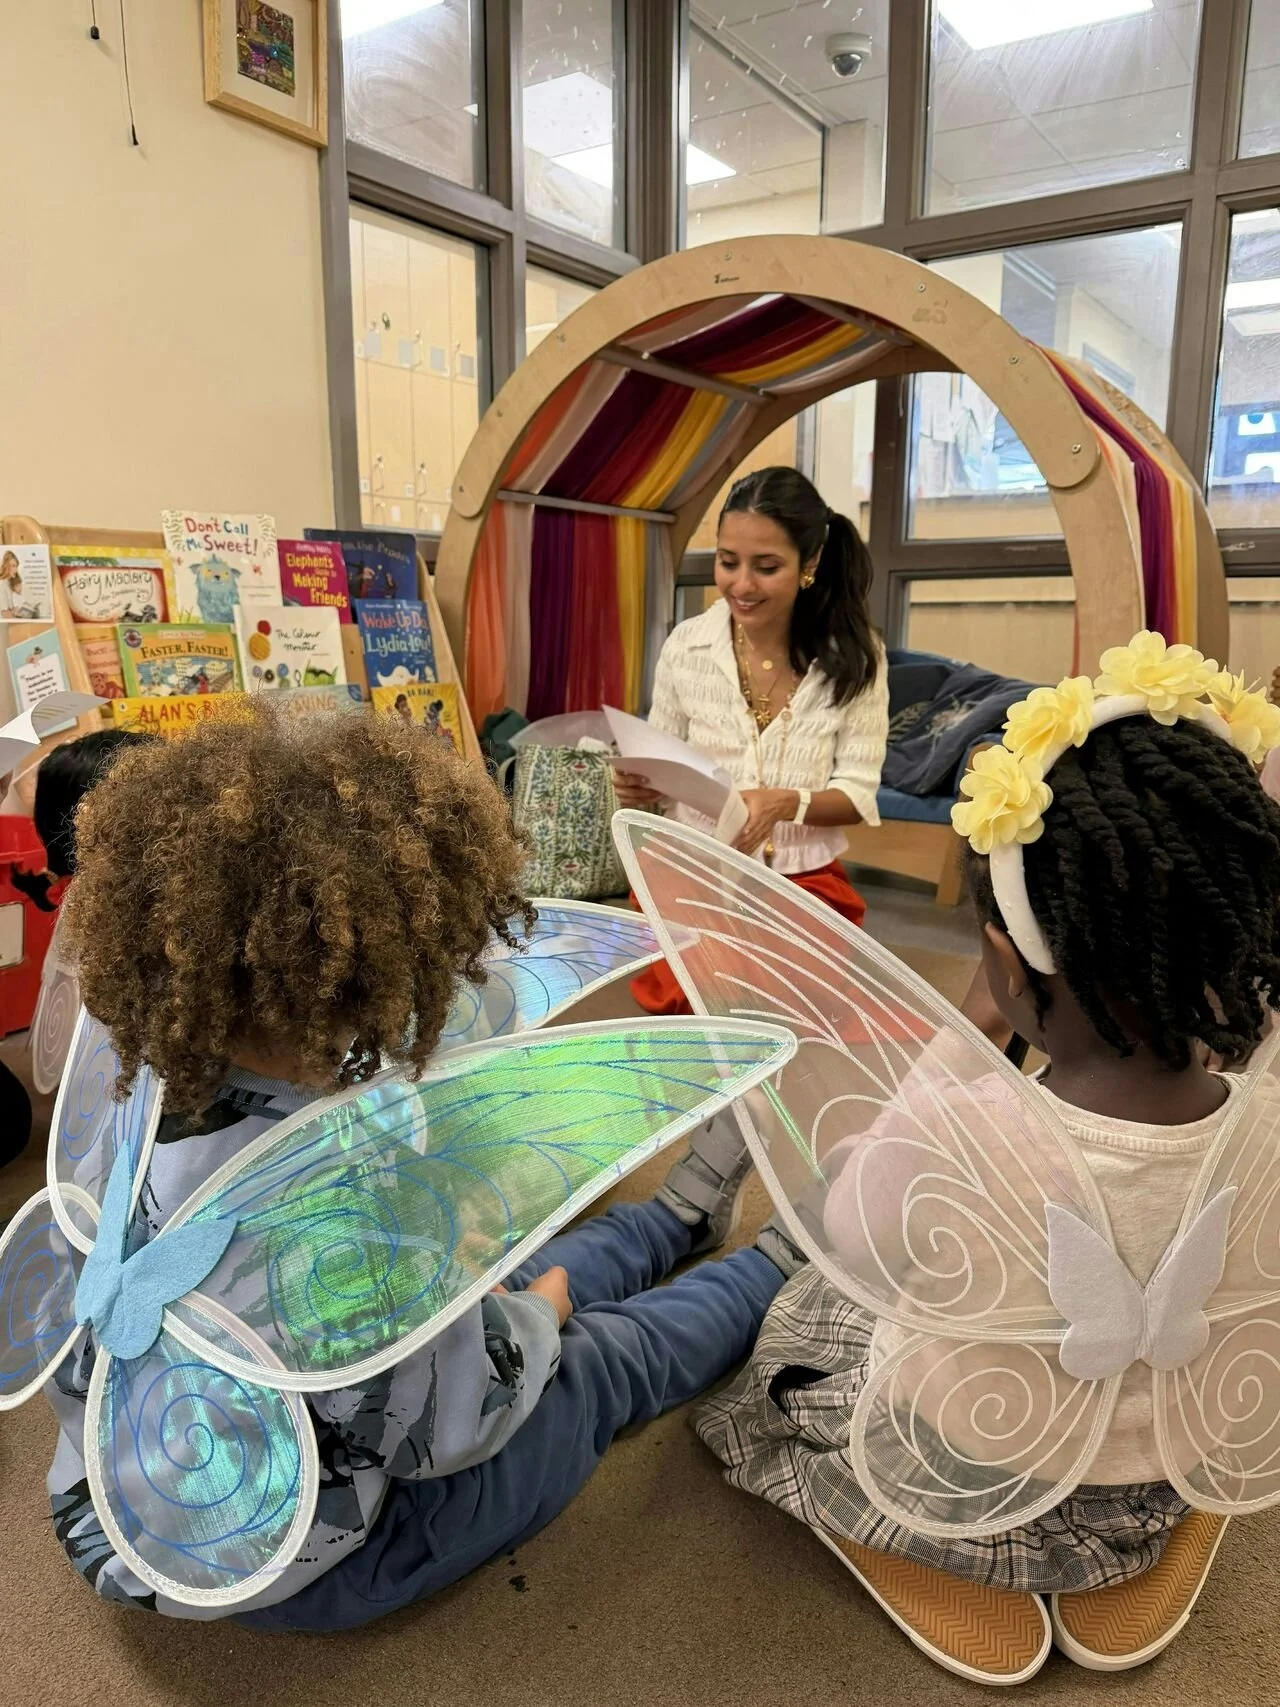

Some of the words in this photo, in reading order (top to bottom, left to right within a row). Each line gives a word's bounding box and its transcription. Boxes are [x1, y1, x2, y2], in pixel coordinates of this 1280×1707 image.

[185, 517, 222, 533] Don't
[223, 520, 248, 535] Call
[204, 534, 258, 556] Sweet!
[285, 552, 335, 570] Elephant's
[67, 573, 102, 606] Hairy
[104, 571, 154, 603] Maclary
[292, 573, 329, 591] Making
[310, 588, 348, 608] Friends
[362, 610, 397, 629] Wake
[395, 610, 412, 632] Up
[275, 628, 290, 640] The
[141, 643, 186, 659] FASTER,
[187, 641, 229, 657] FASTER!
[365, 632, 409, 657] Lydia
[138, 700, 197, 723] ALAN'S
